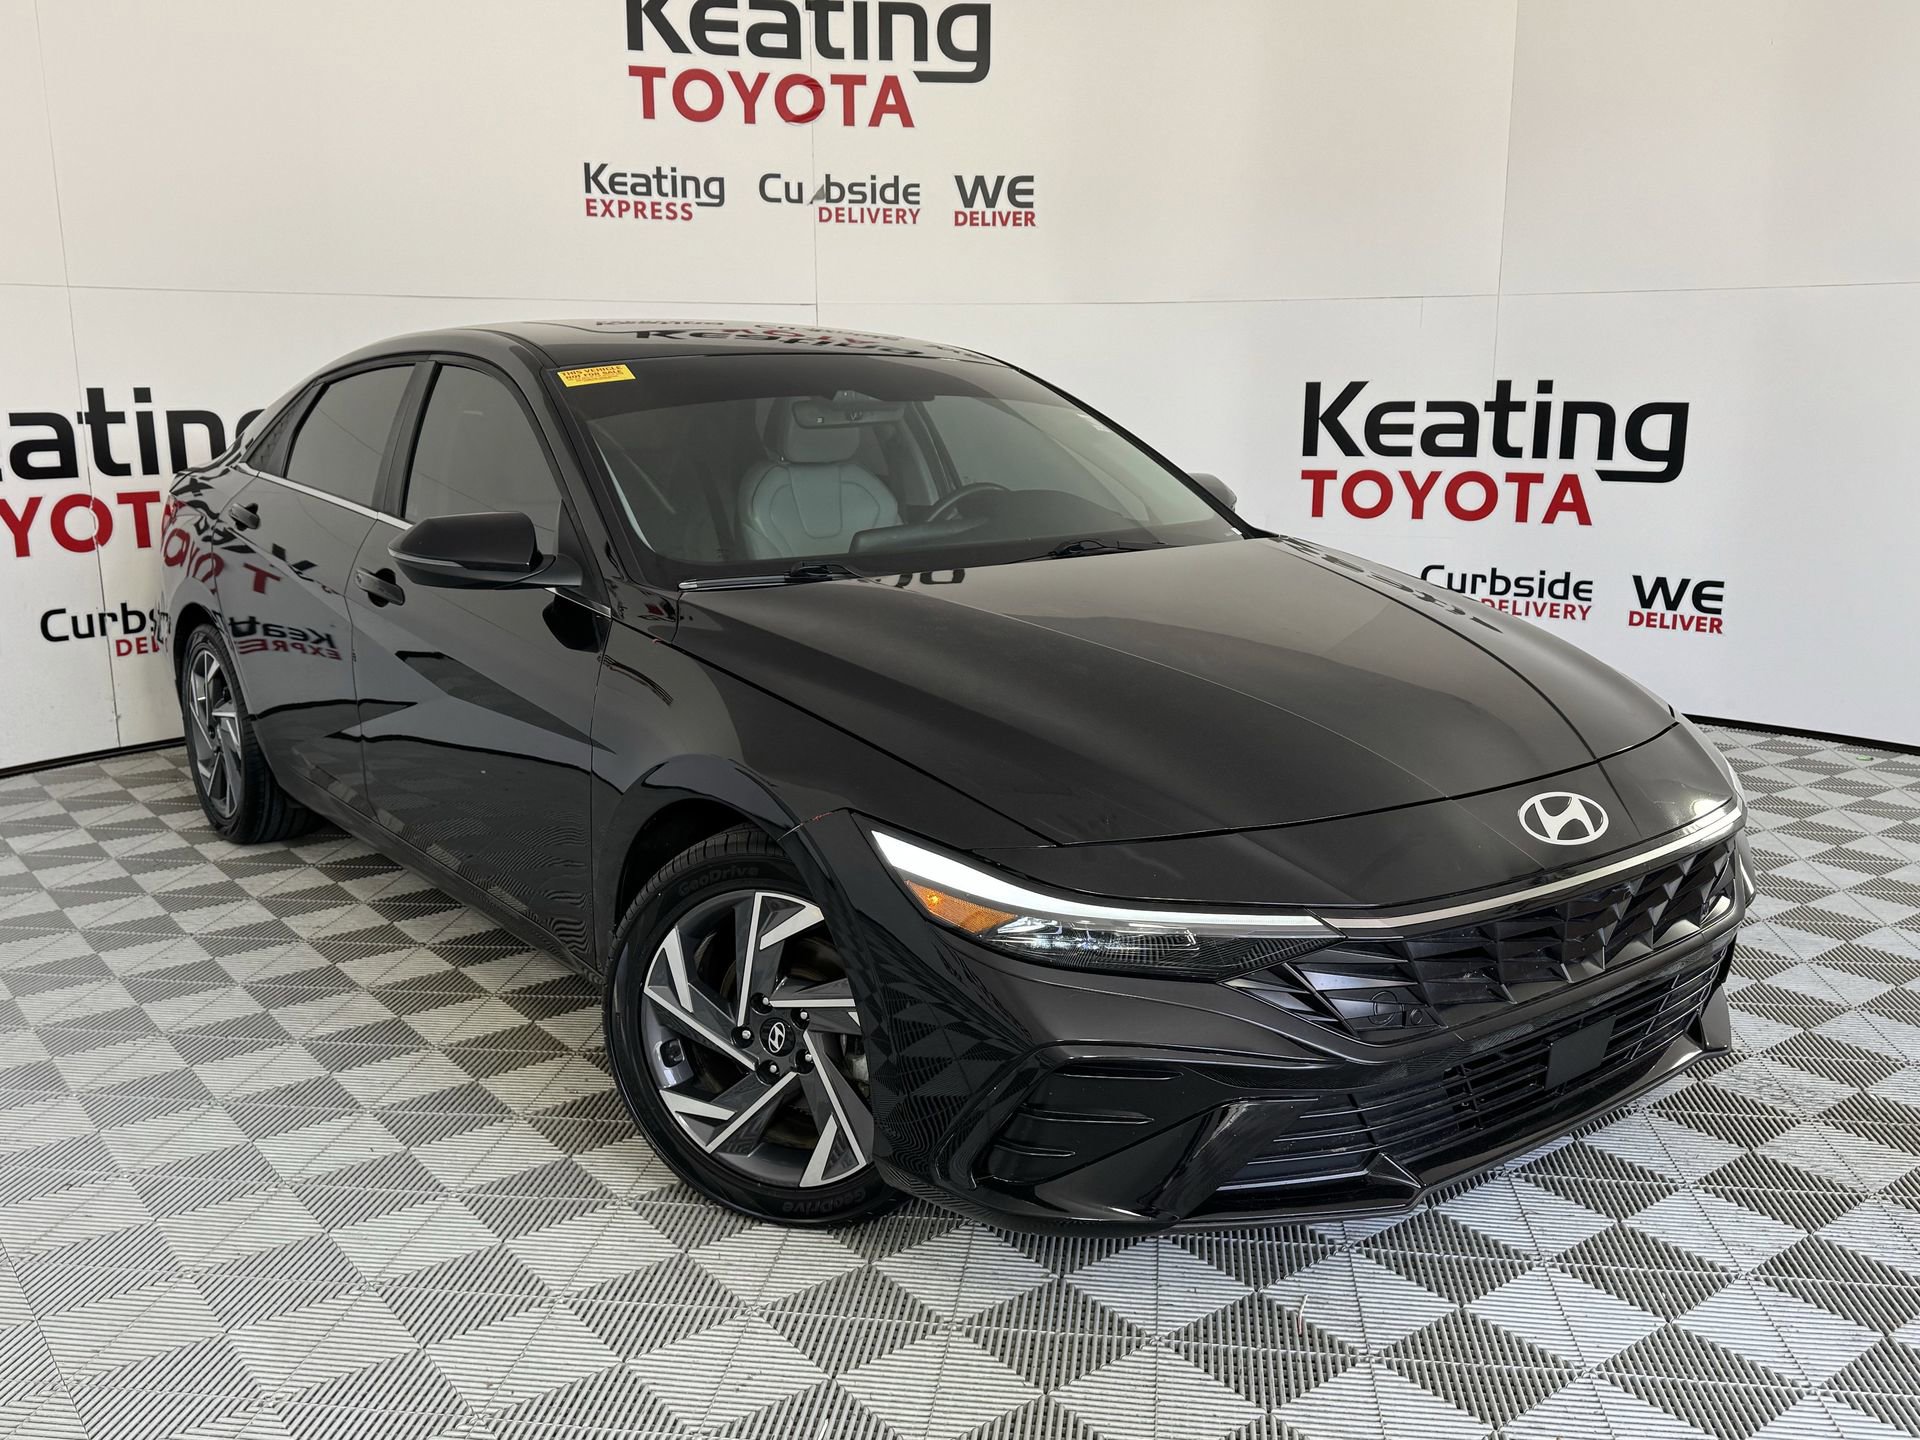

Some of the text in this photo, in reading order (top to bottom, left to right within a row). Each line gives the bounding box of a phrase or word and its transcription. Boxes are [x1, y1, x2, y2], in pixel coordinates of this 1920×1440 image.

[626, 0, 991, 84] Keating
[628, 65, 915, 128] TOYOTA
[583, 162, 725, 208] Keating
[758, 173, 921, 205] Cubside
[954, 174, 1035, 209] WE
[585, 198, 694, 222] EXPRESS
[818, 206, 921, 225] DELIVERY
[954, 210, 1036, 227] DELIVER
[1302, 379, 1690, 483] Keating
[1301, 470, 1592, 526] TOYOTA
[1632, 575, 1725, 615] WE
[1628, 611, 1723, 634] DELIVER
